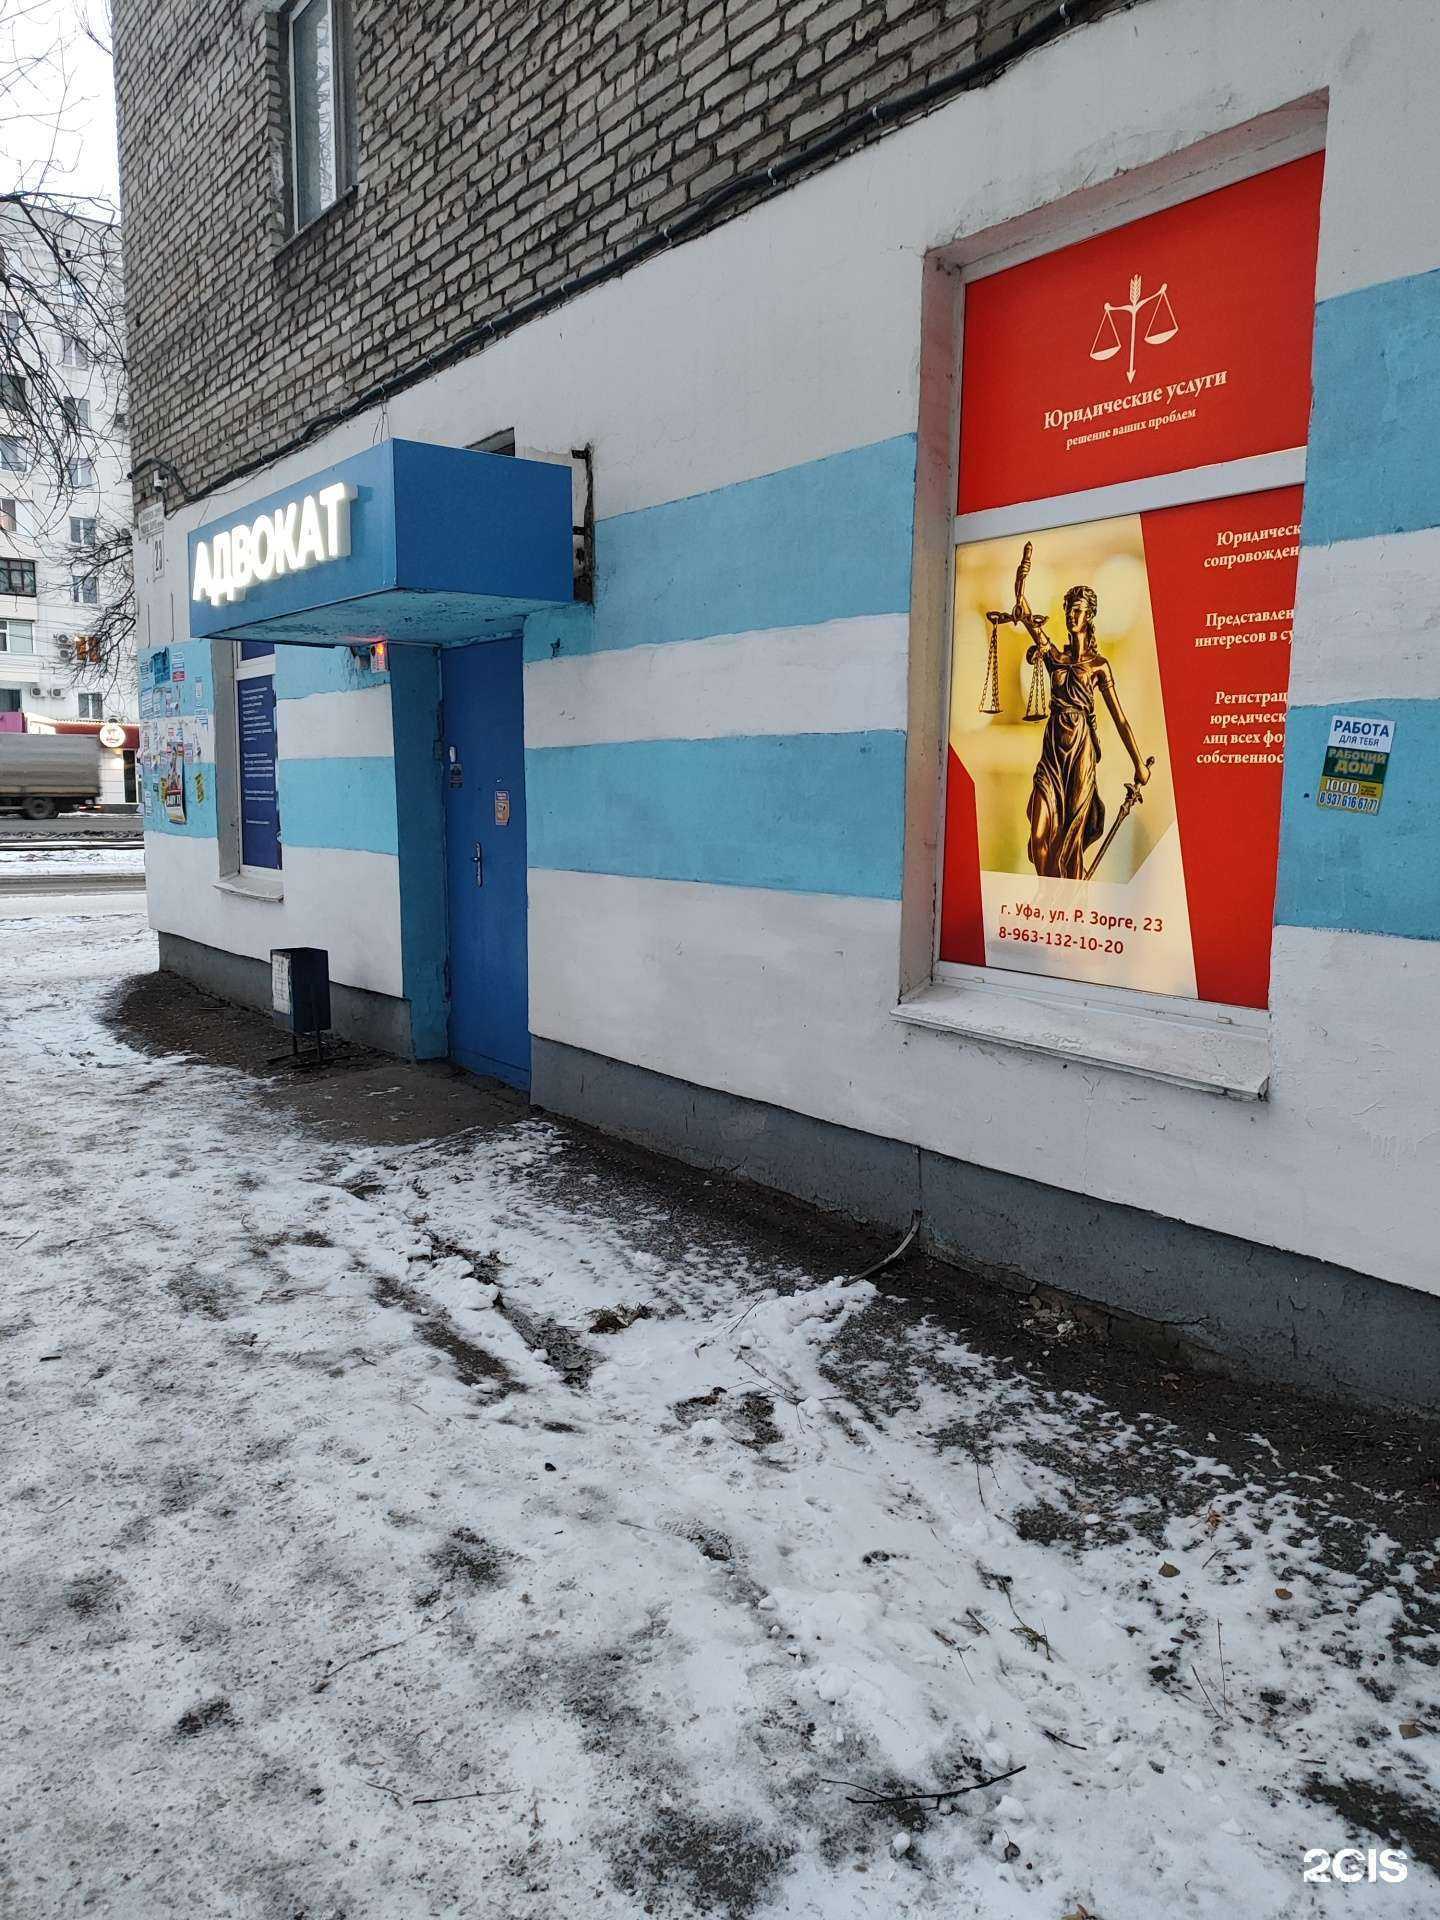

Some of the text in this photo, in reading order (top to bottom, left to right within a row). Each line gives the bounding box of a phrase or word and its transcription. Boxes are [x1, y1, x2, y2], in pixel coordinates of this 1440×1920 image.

[1043, 370, 1228, 430] Юридические услуги
[1066, 408, 1197, 450] решение ваших проблем
[192, 482, 358, 606] АДВОКАТ
[1216, 524, 1301, 548] Юридическ
[1203, 545, 1299, 569] сопровожден
[1205, 609, 1294, 631] Представлен
[1194, 631, 1266, 649] интересов
[1269, 631, 1278, 641] в
[1203, 730, 1285, 748] лиц всех фо
[1333, 719, 1390, 738] РАБОТА
[1339, 734, 1380, 747] ДЛЯ ТЕБЯ
[1328, 748, 1387, 764] РАБОЧИЙ
[1334, 760, 1375, 776] ДОМ
[1325, 779, 1360, 795] 1000
[1001, 903, 1164, 933] г. Уфа, ул. Р. Зорге, 23
[998, 926, 1124, 955] 8-963-132-10-20
